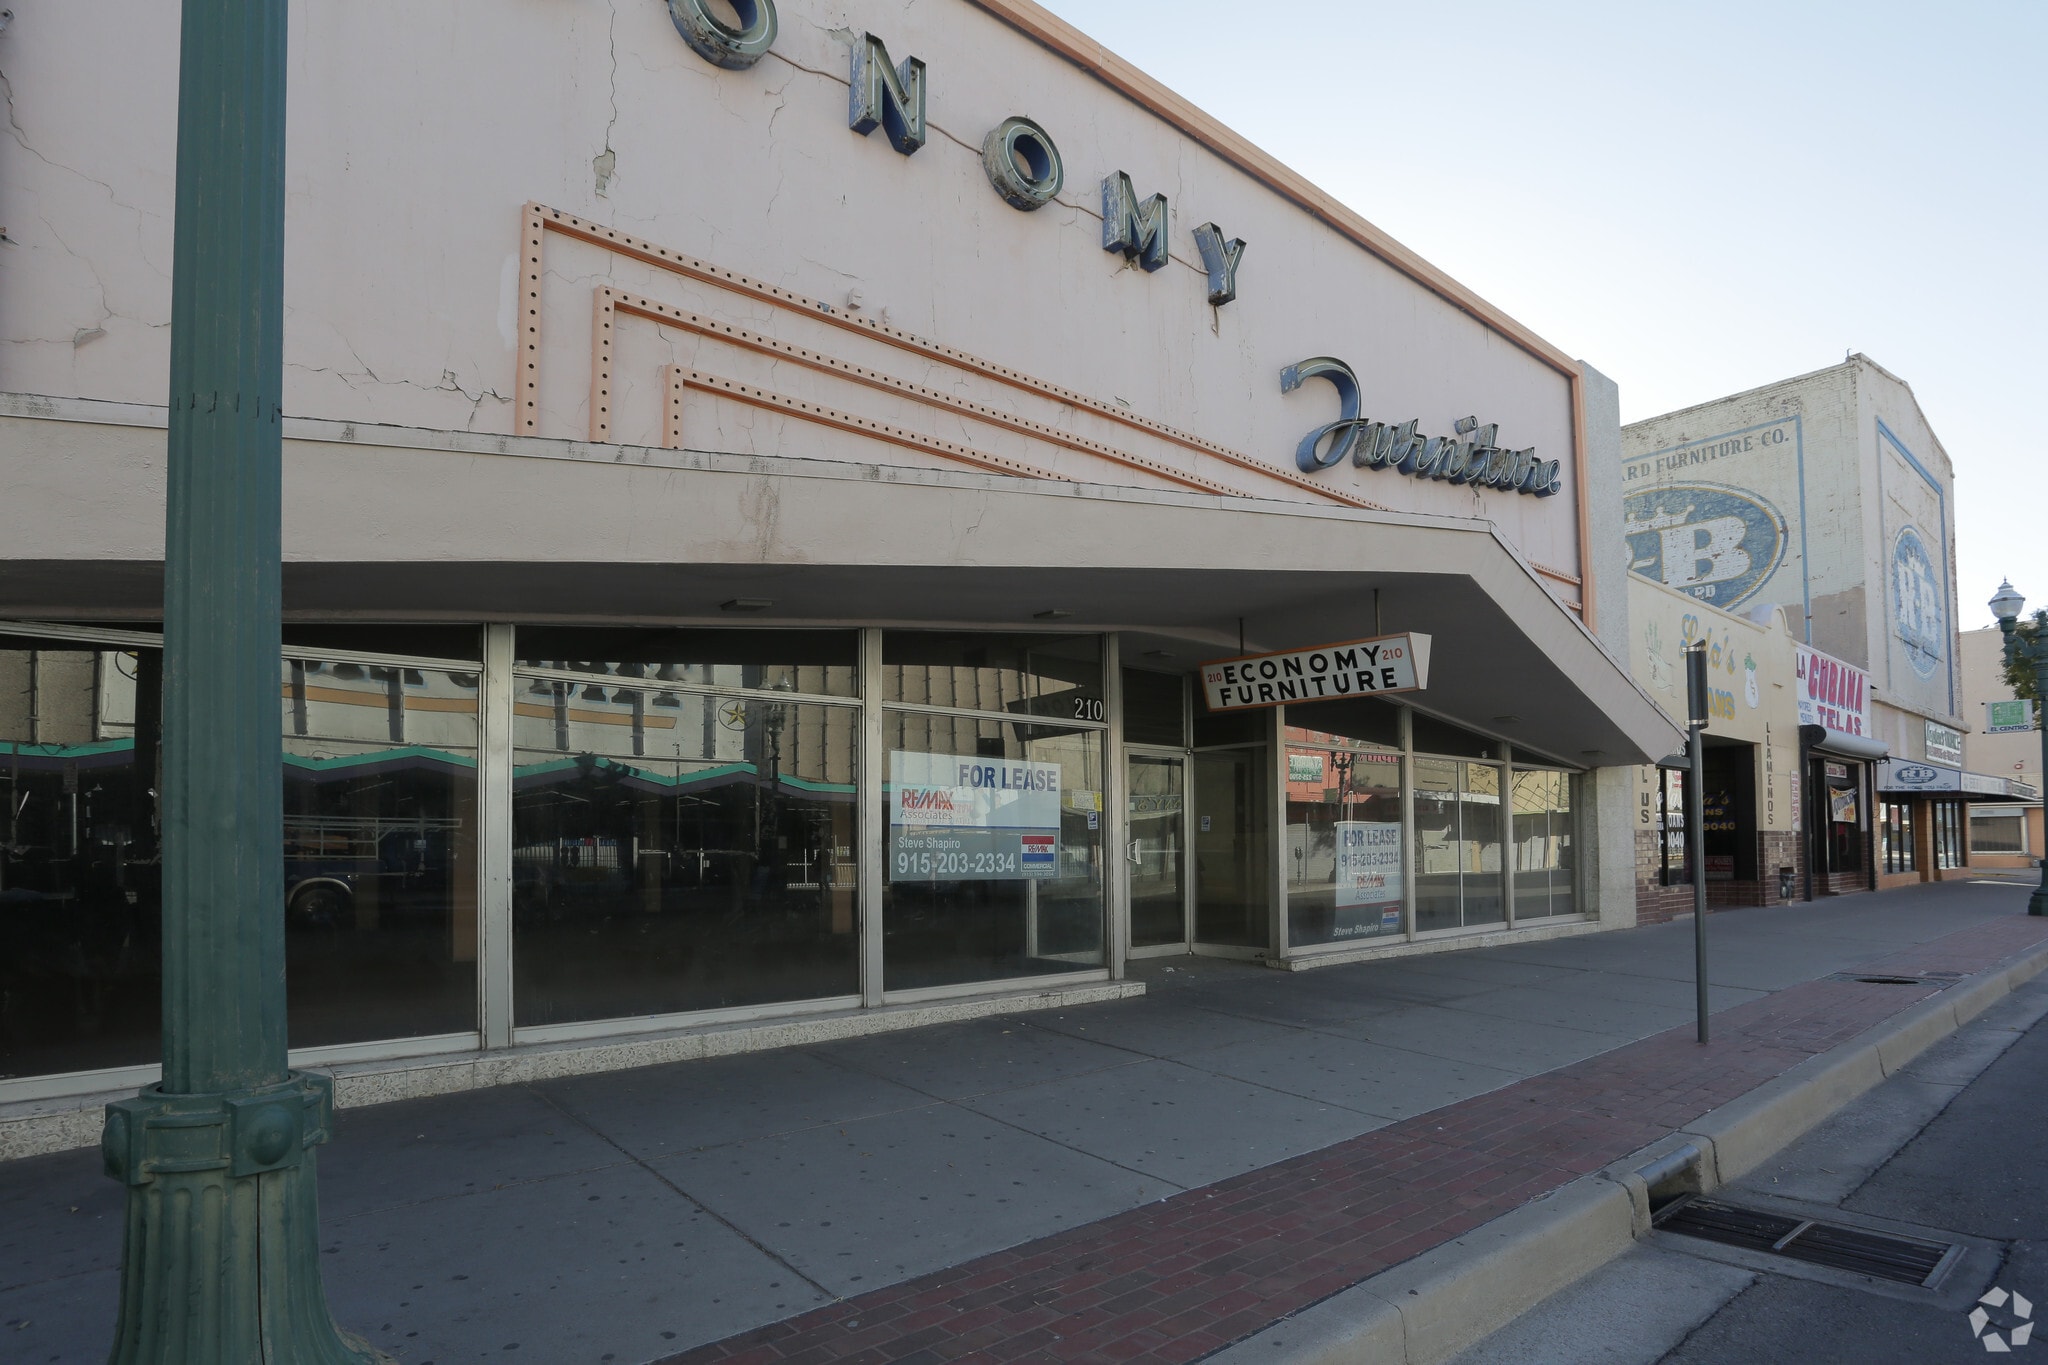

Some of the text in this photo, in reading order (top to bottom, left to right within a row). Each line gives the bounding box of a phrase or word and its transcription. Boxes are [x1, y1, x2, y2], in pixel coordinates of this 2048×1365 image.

[1280, 356, 1562, 498] Furniture
[1656, 436, 1753, 473] FURNITURE
[1761, 428, 1790, 447] CO.
[1207, 645, 1403, 685] 210 ECONOMY 210
[1220, 667, 1397, 706] FURNITURE
[1796, 653, 1863, 715] LA CUBANA
[1075, 698, 1104, 721] 210
[1817, 705, 1862, 737] TELAS
[1999, 724, 2029, 732] CENTRO
[958, 764, 1057, 791] FOR LEASE
[901, 788, 954, 810] RE/MAX
[900, 810, 953, 820] Associates
[1668, 815, 1685, 828] OANS
[898, 837, 960, 851] Steve Shapiro
[1028, 845, 1049, 853] RE/MAX
[1344, 829, 1397, 847] FOR LEASE
[898, 852, 1015, 874] 915-203-2334
[1023, 862, 1053, 870] COMMERCIAL
[1333, 926, 1353, 937] Steve
[1354, 923, 1379, 934] Shapiro
